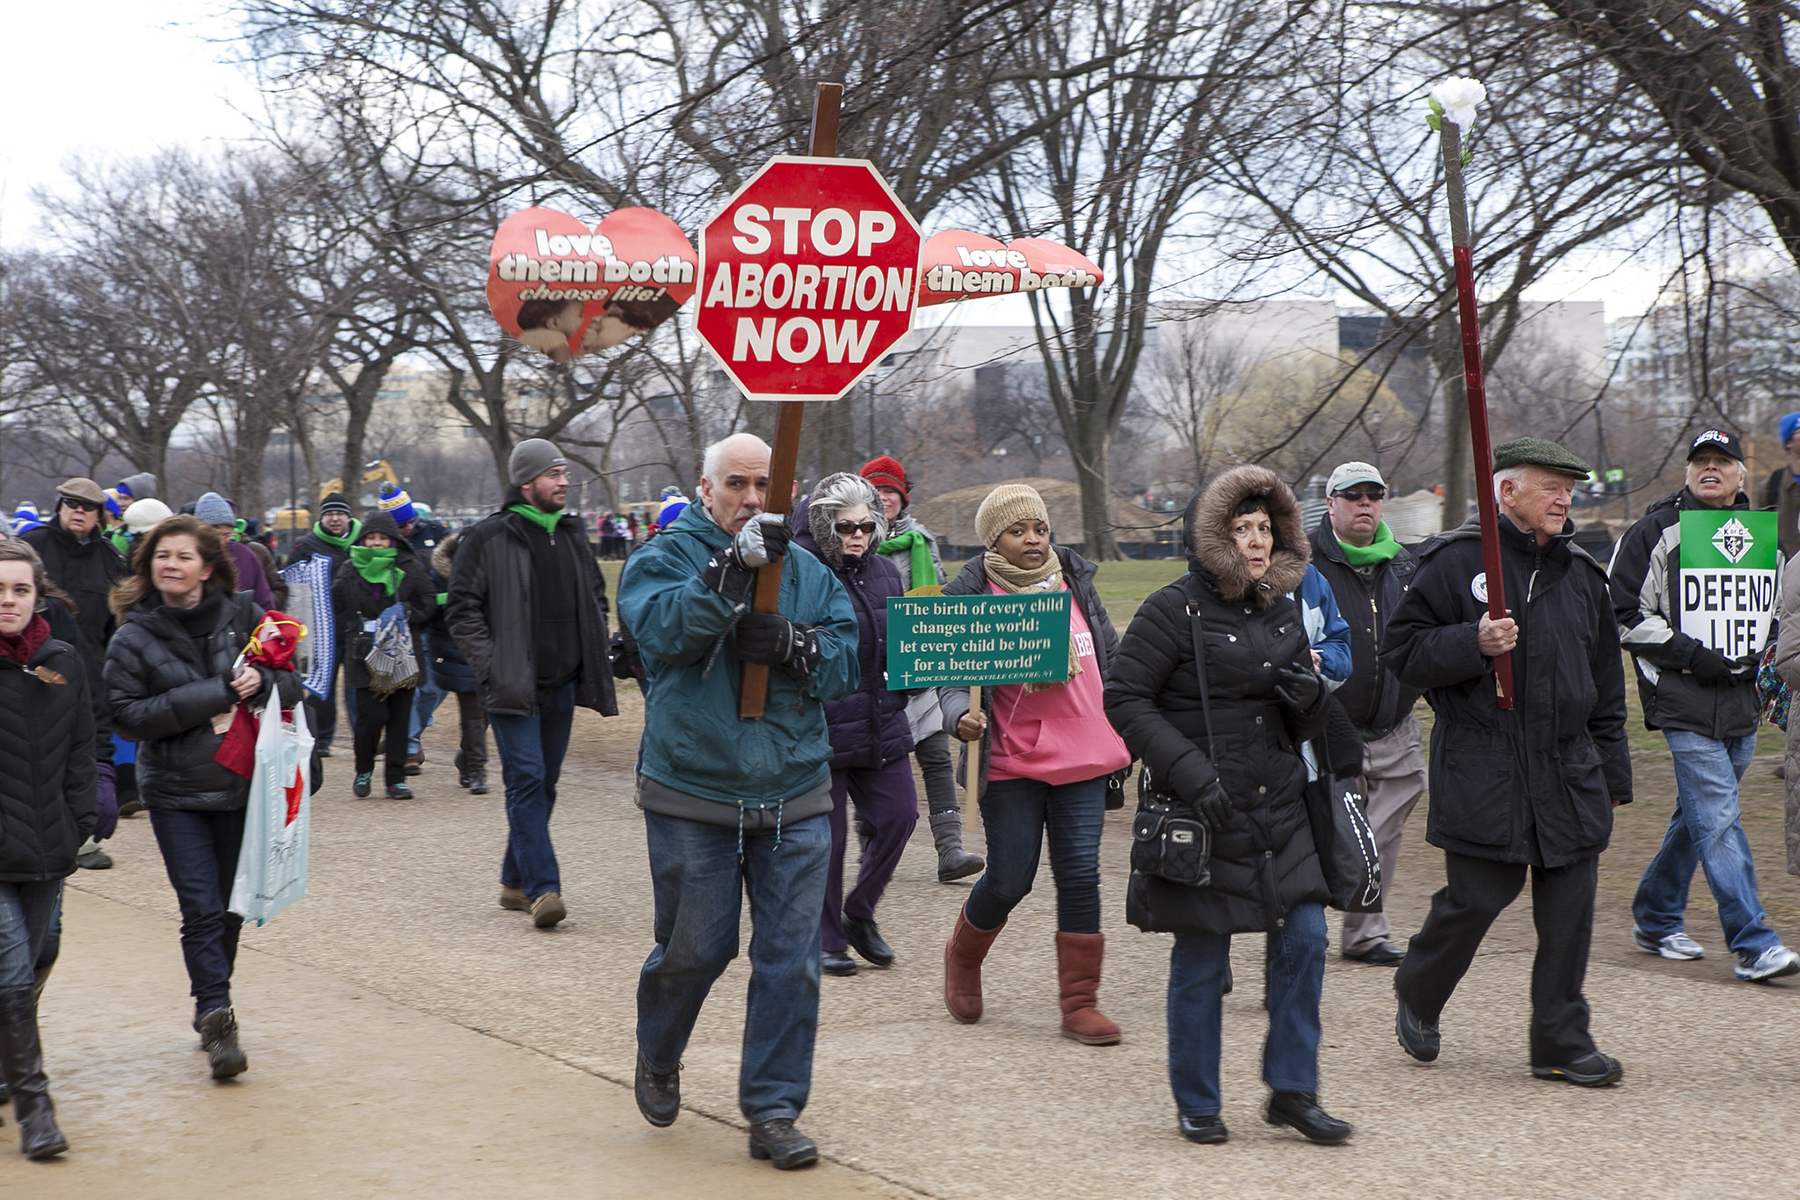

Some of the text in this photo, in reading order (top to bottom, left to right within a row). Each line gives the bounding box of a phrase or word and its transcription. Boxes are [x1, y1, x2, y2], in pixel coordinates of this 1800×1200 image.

[534, 228, 614, 257] love
[732, 204, 897, 257] STOP
[497, 252, 694, 284] them both
[955, 246, 1028, 269] love
[518, 283, 668, 302] choose life!
[704, 262, 913, 312] ABORTION
[926, 263, 1097, 293] them both
[732, 316, 880, 364] NOW
[894, 597, 1064, 617] "The birth of every child
[1684, 574, 1772, 612] DEFEND
[911, 618, 1039, 637] changes the world:
[1711, 619, 1756, 656] LIFE
[900, 637, 1051, 656] let every child be born
[914, 653, 1041, 671] for a better world"
[963, 673, 1007, 681] ROCKVILLE
